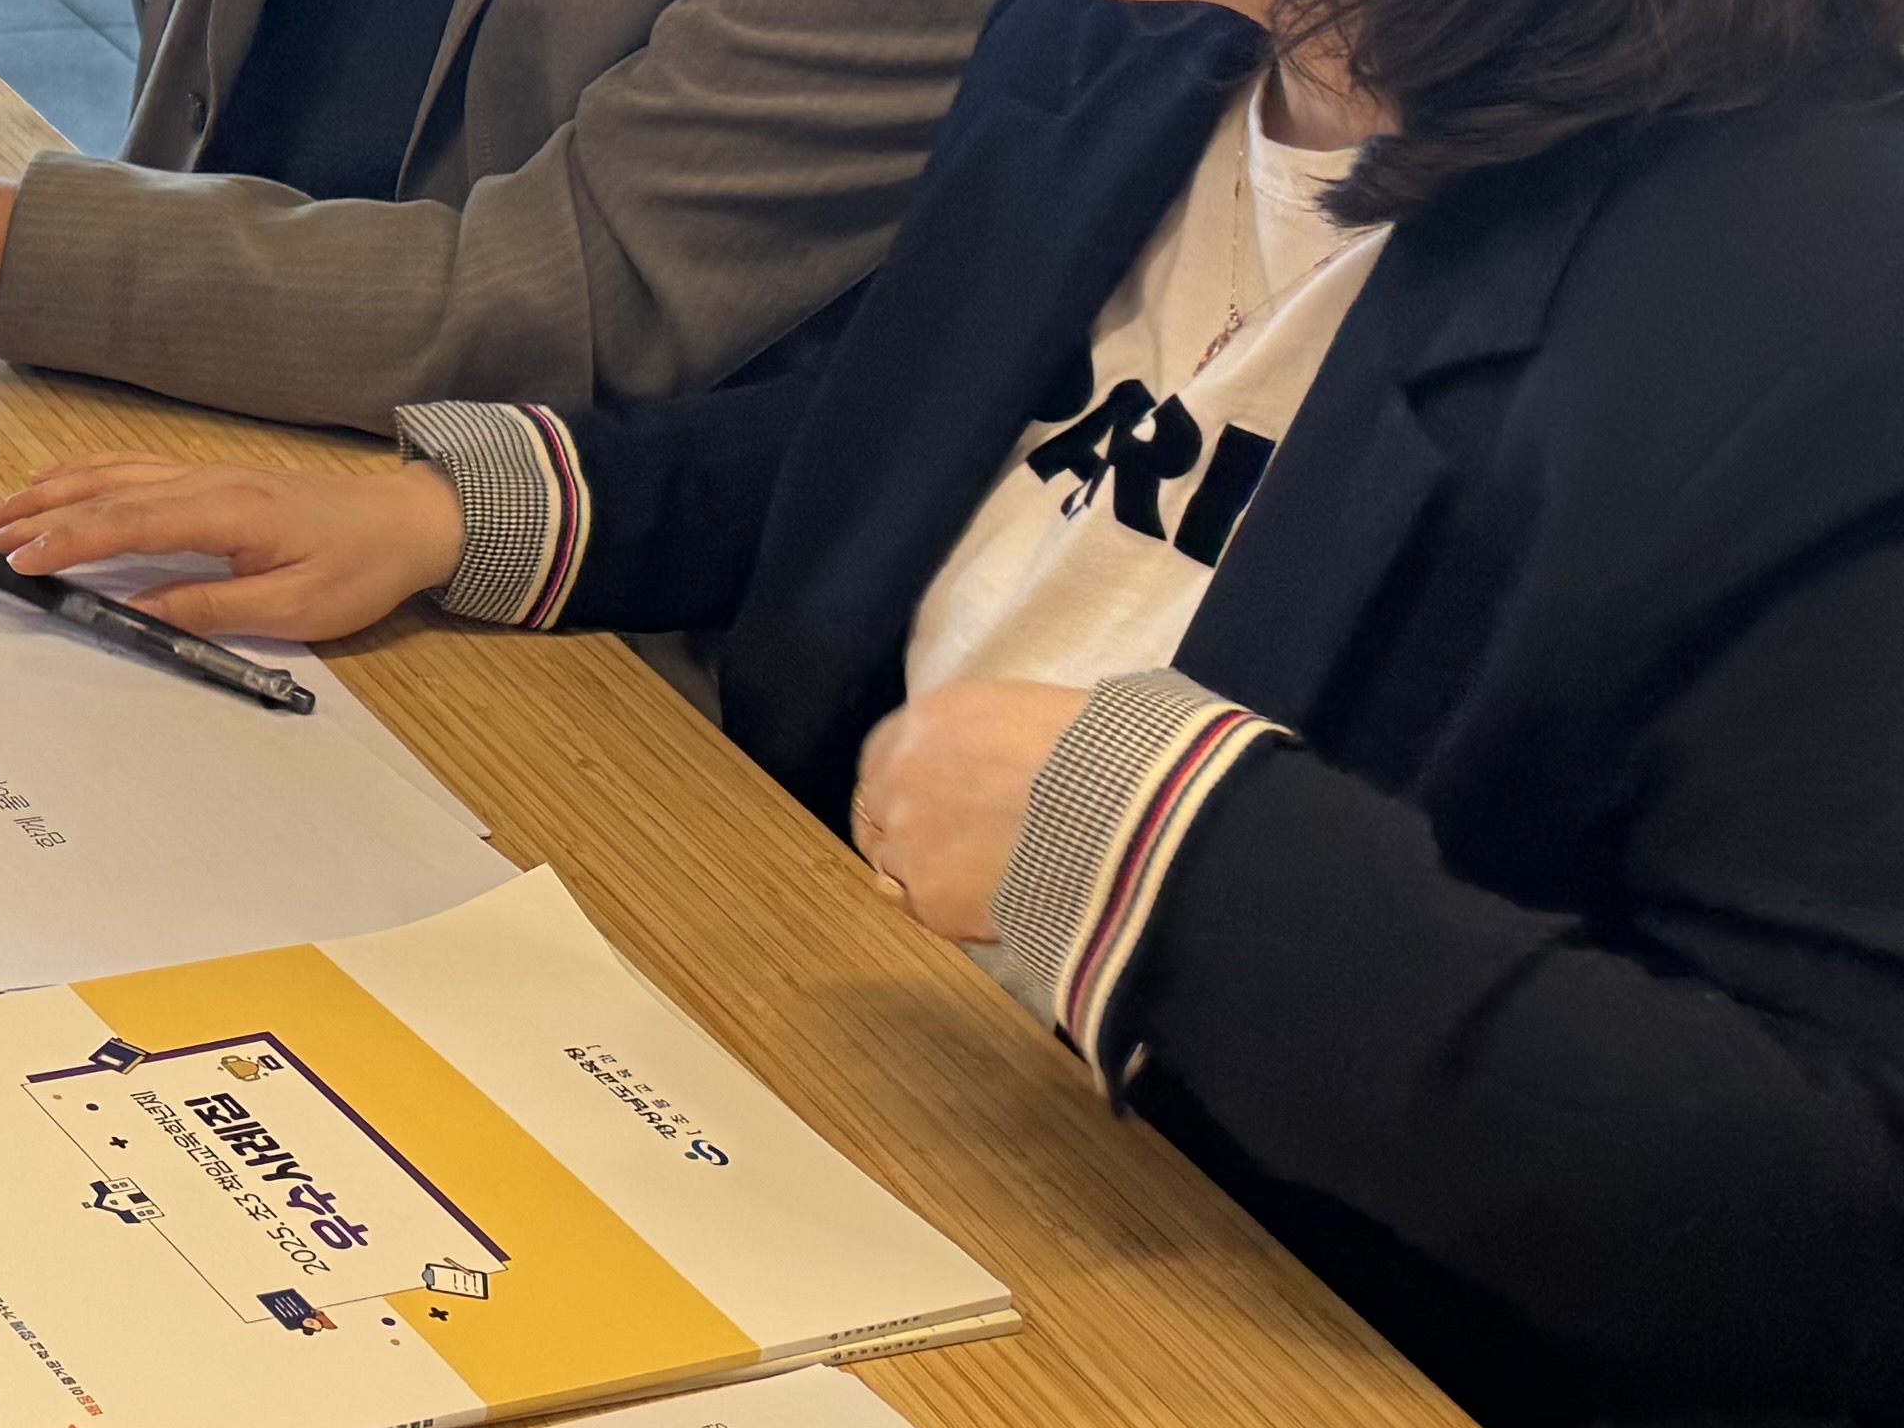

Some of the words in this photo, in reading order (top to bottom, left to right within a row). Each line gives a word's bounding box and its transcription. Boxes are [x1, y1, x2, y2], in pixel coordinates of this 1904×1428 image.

[13, 816, 66, 848] 함께
[130, 1091, 242, 1192] 책임교육학년제
[184, 1093, 368, 1249] 우수사례집
[233, 1194, 277, 1220] 초3
[267, 1222, 331, 1275] 2025.
